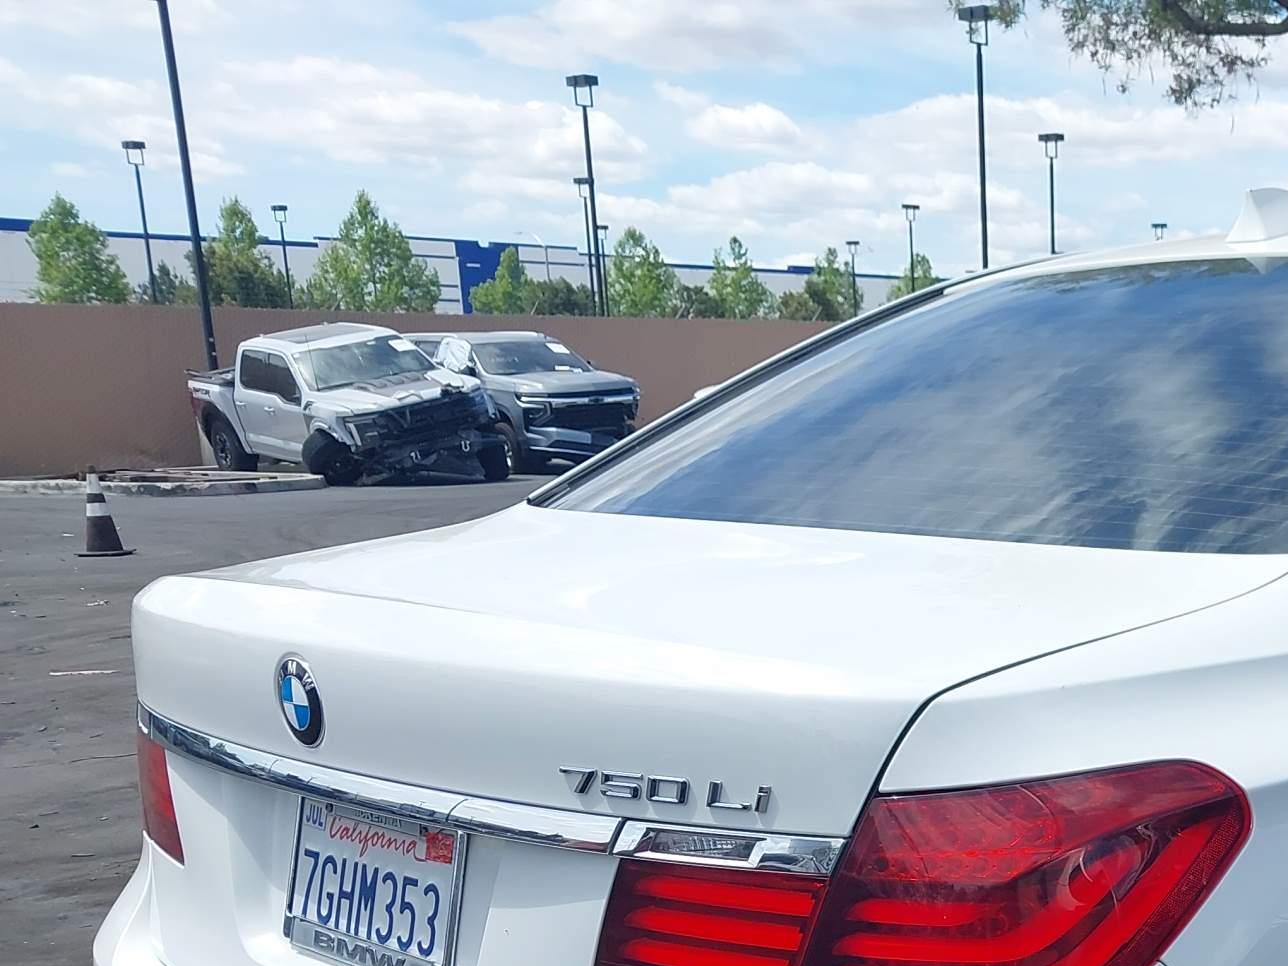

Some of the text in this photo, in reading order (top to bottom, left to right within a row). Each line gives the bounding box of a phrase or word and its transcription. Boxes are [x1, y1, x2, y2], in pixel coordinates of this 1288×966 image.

[305, 803, 324, 828] JUL
[327, 816, 427, 862] California
[301, 848, 440, 957] 7GHM353
